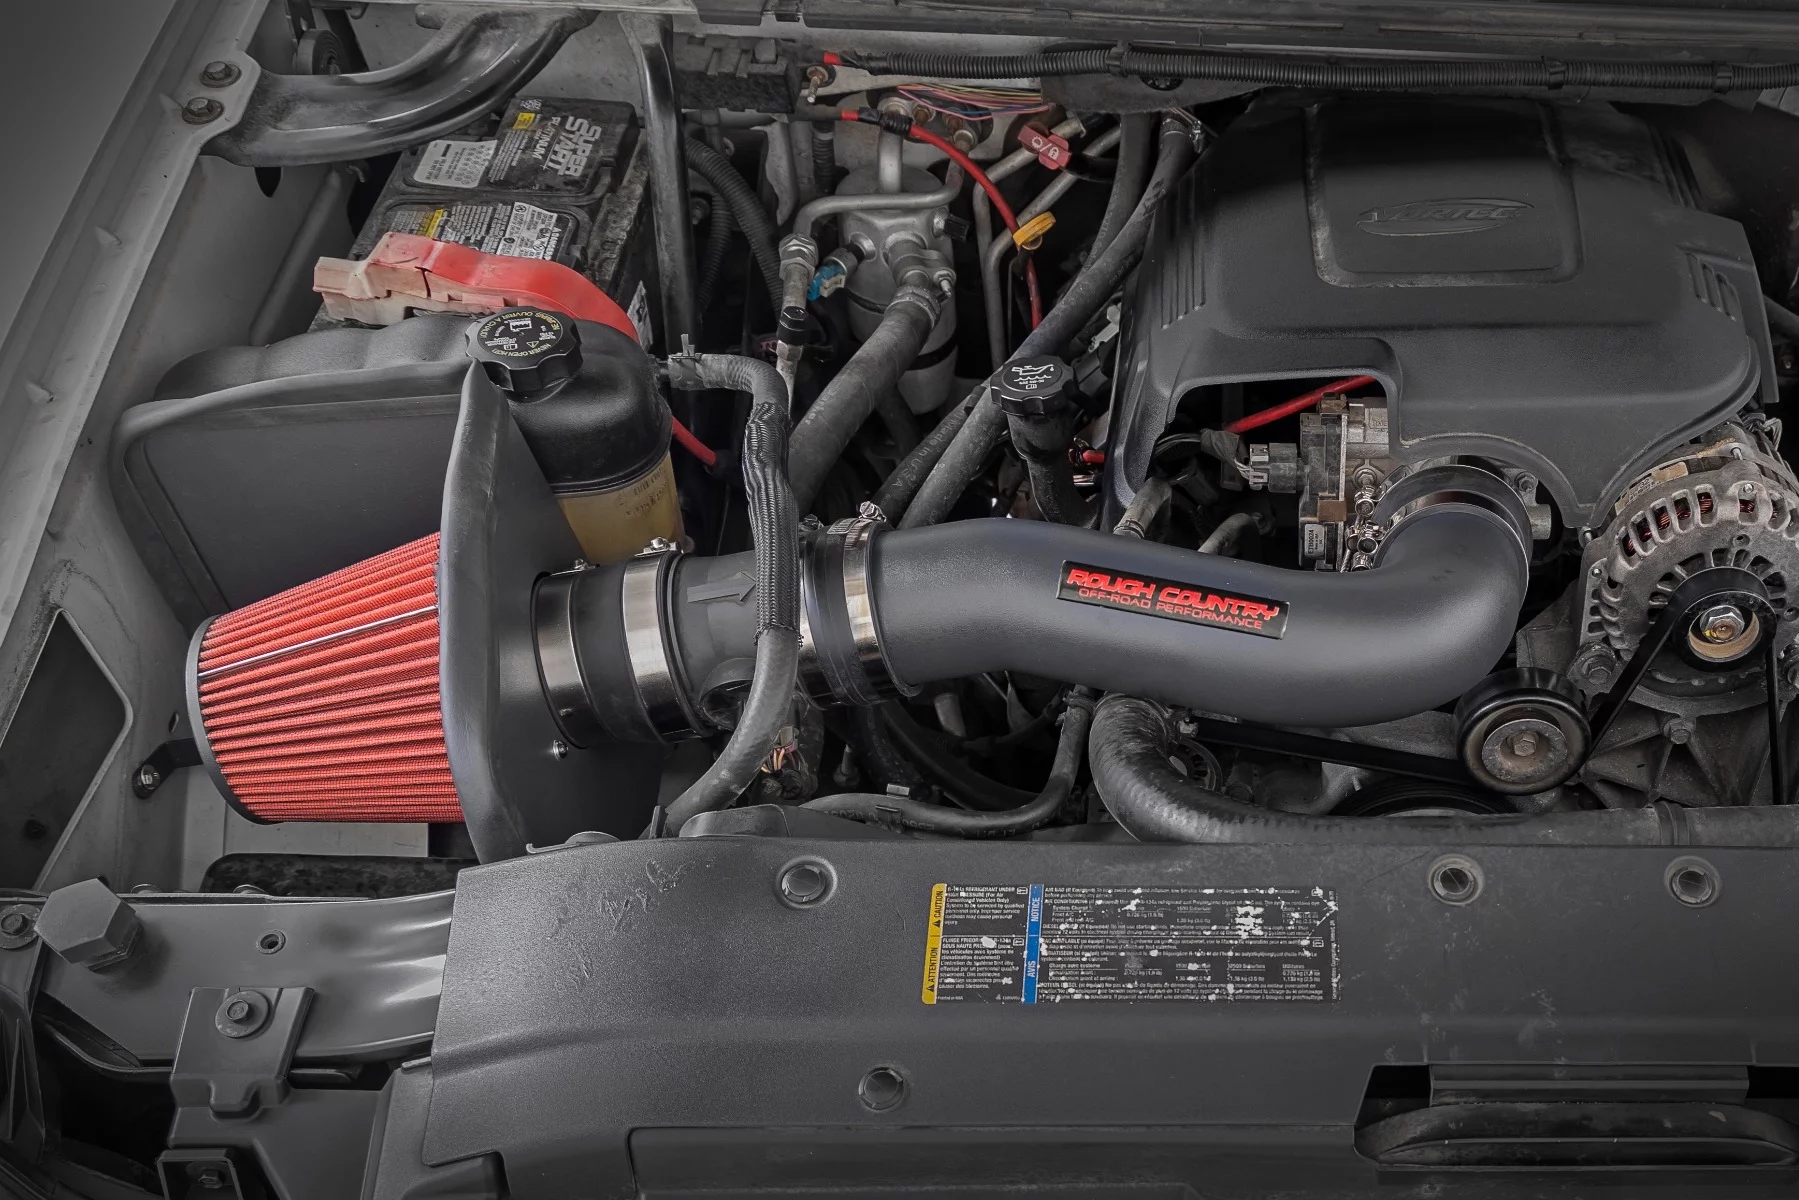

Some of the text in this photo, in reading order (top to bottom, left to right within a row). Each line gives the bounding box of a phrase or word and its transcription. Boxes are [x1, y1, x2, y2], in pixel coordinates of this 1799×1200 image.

[531, 116, 562, 160] PLATINUM
[548, 115, 590, 176] START
[565, 125, 602, 177] SUPER
[503, 311, 533, 320] OUVRIR
[527, 343, 552, 355] NEVER
[929, 418, 956, 446] Made
[1066, 568, 1280, 621] ROUGH COUNTRY
[1078, 588, 1263, 631] OFF-ROAD PERFORMANCE
[934, 890, 944, 918] CAUTION
[1030, 897, 1040, 922] NOTICE
[928, 947, 938, 983] ATTENTION
[1027, 960, 1036, 978] AVIS
